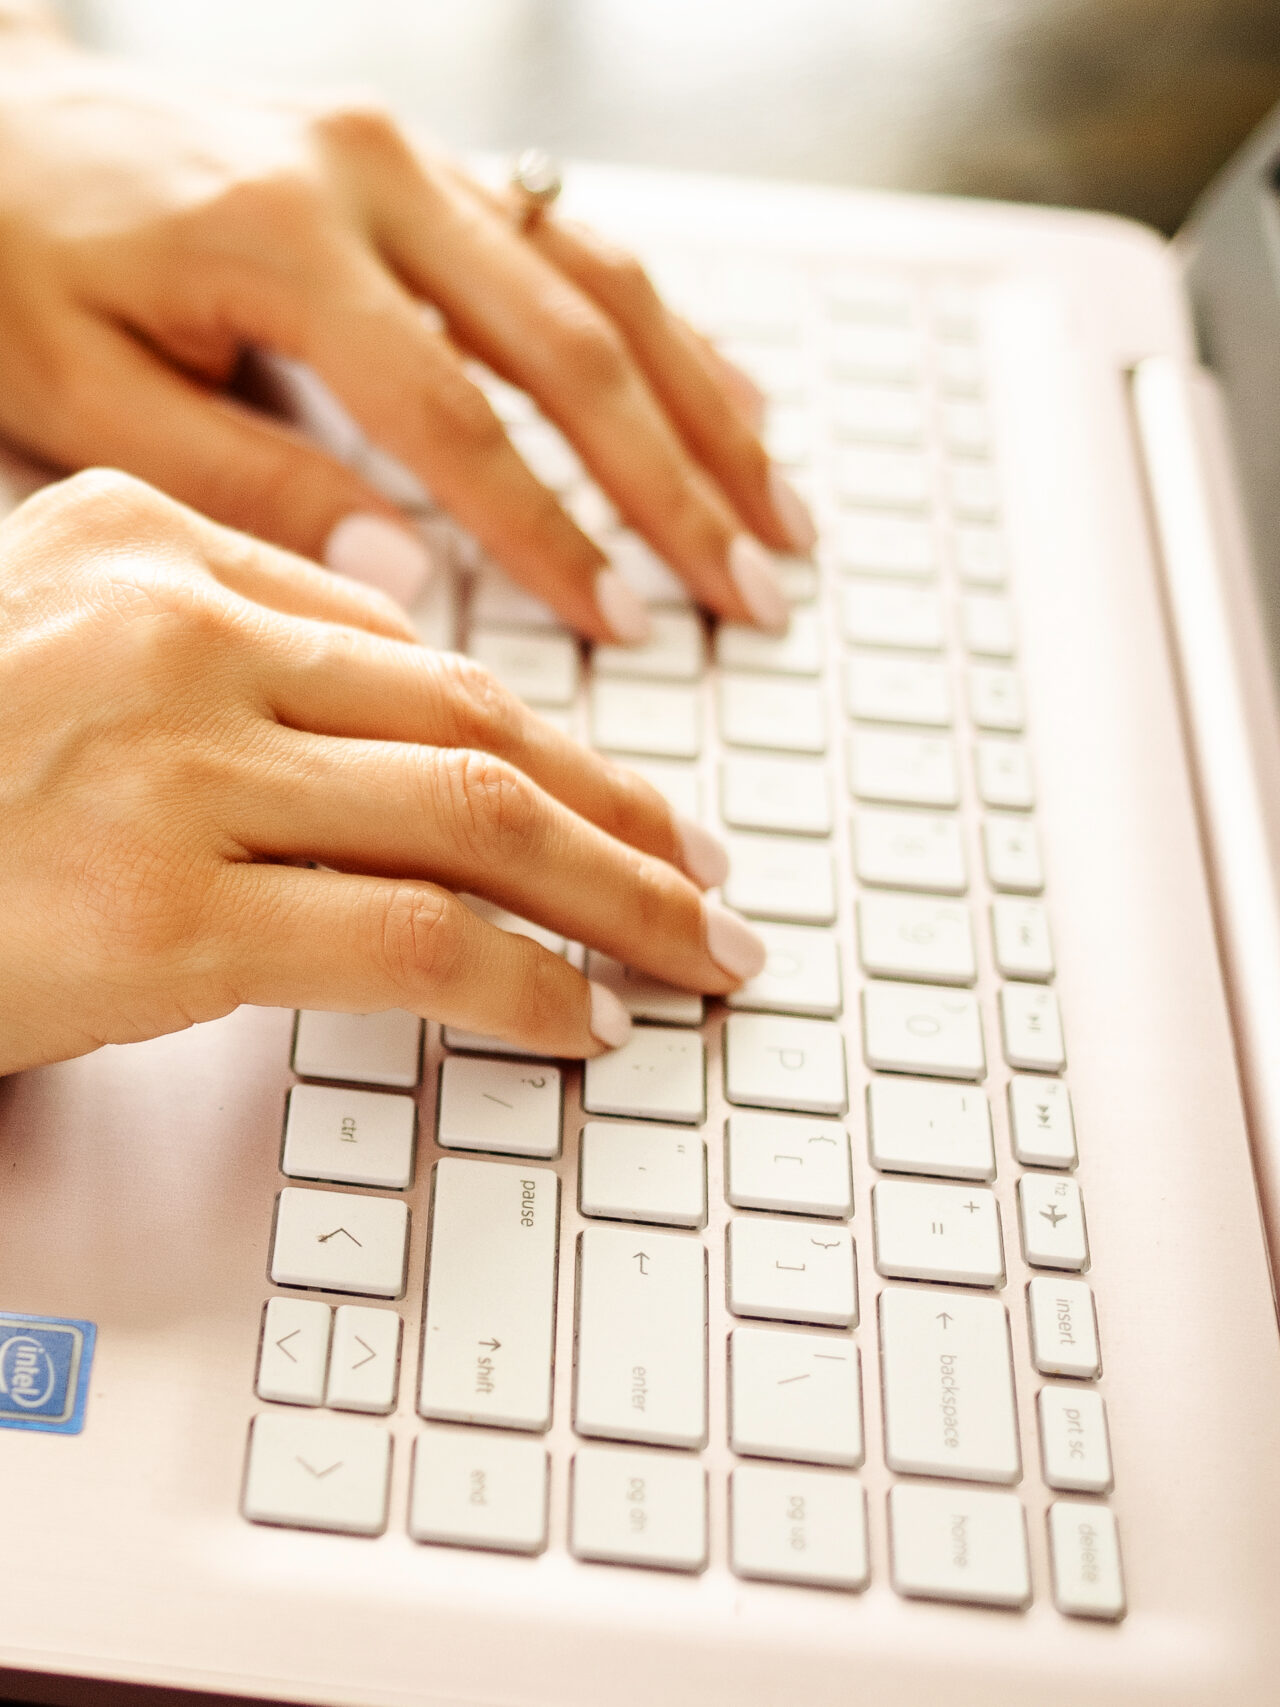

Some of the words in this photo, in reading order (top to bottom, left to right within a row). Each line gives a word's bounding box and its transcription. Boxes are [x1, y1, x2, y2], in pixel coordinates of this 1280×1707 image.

[765, 1045, 805, 1071] P
[521, 1076, 546, 1089] ?
[482, 1092, 514, 1109] /
[339, 1116, 358, 1143] ctrl
[807, 1135, 838, 1146] {
[773, 1153, 804, 1166] [
[520, 1178, 536, 1228] pause
[962, 1200, 982, 1214] +
[931, 1221, 945, 1236] =
[811, 1238, 841, 1250] }
[775, 1258, 806, 1271] ]
[1055, 1297, 1076, 1346] insert
[12, 1346, 45, 1396] intel
[476, 1356, 496, 1395] shift
[631, 1366, 648, 1413] enter
[939, 1353, 960, 1450] backspace
[1063, 1407, 1084, 1435] prt
[1068, 1440, 1086, 1462] sc
[469, 1468, 488, 1507] end
[626, 1476, 646, 1504] pg
[789, 1494, 806, 1521] pg
[629, 1508, 648, 1535] dn
[790, 1524, 808, 1552] up
[950, 1512, 971, 1569] home
[1077, 1521, 1099, 1584] delete
